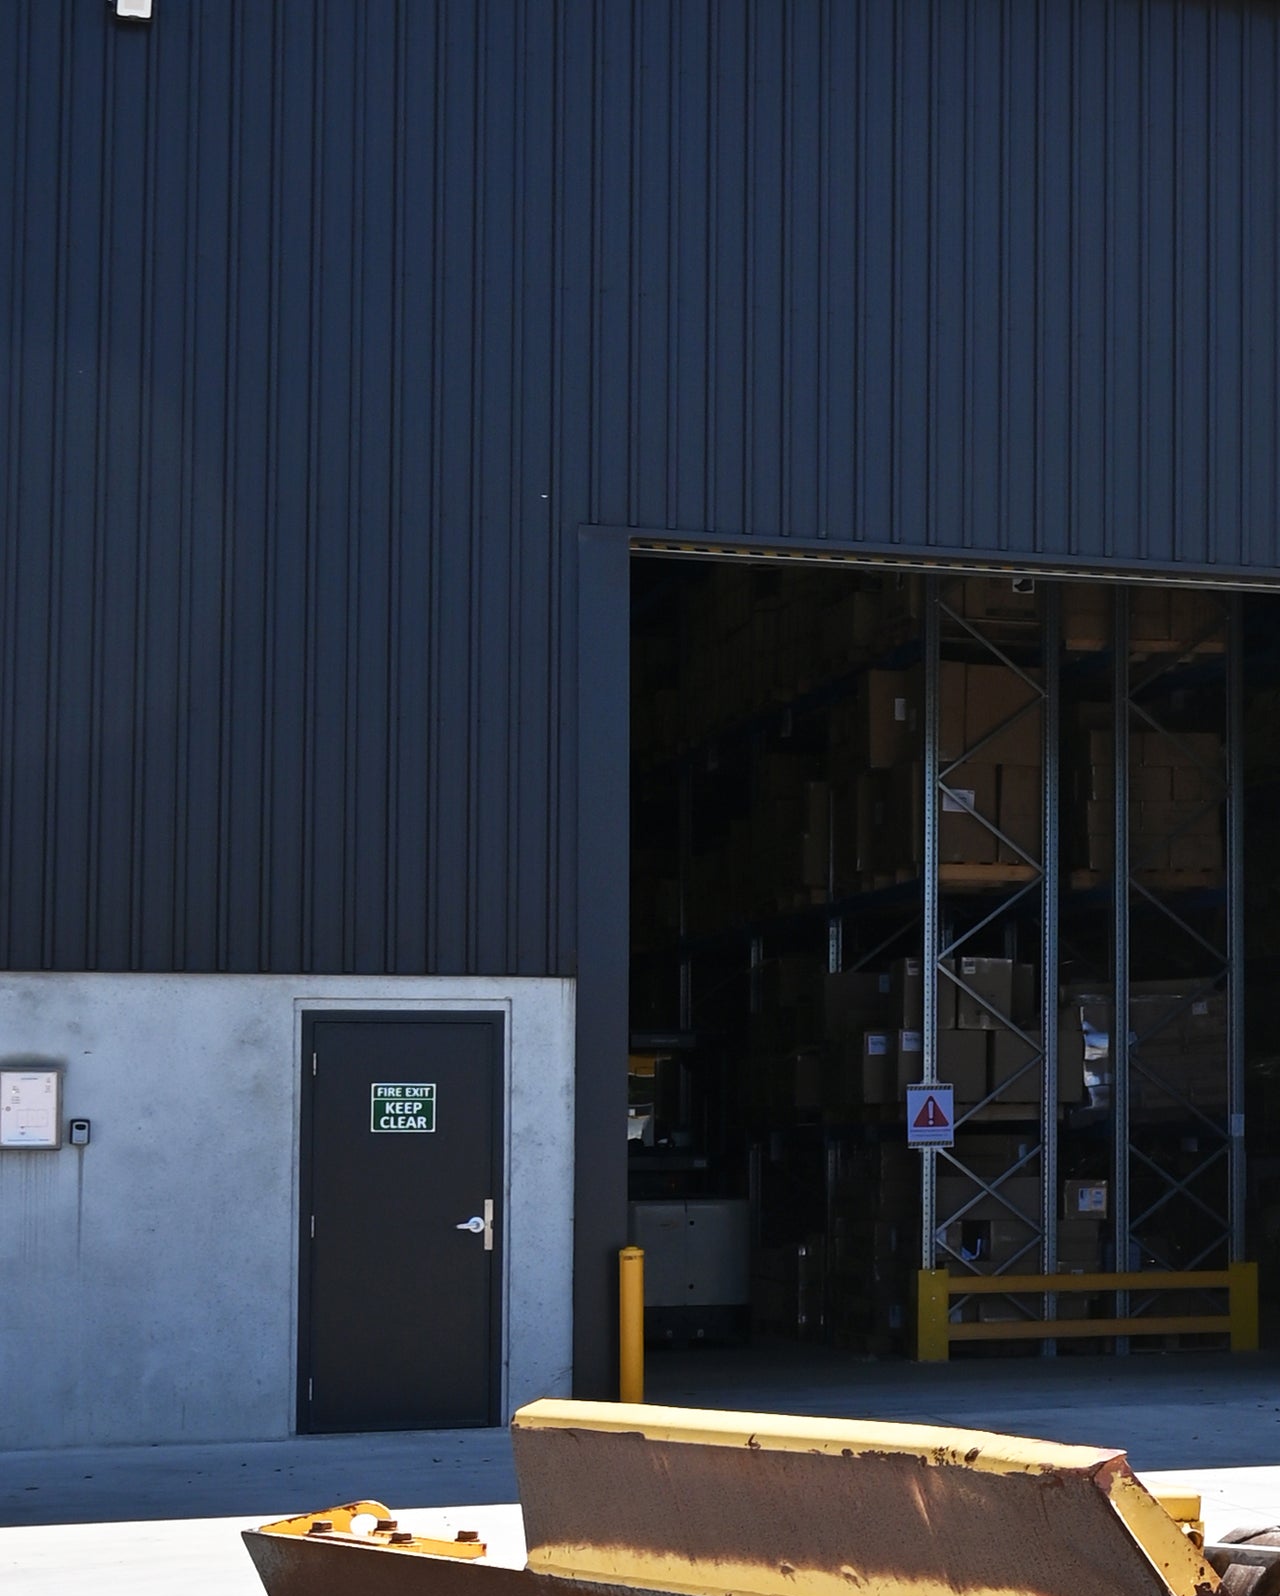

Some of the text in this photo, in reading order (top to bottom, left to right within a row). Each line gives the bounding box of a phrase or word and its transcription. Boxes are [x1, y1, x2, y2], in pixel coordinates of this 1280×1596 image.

[377, 1087, 431, 1097] FIRE EXIT
[385, 1102, 423, 1114] KEEP
[380, 1116, 427, 1129] CLEAR
